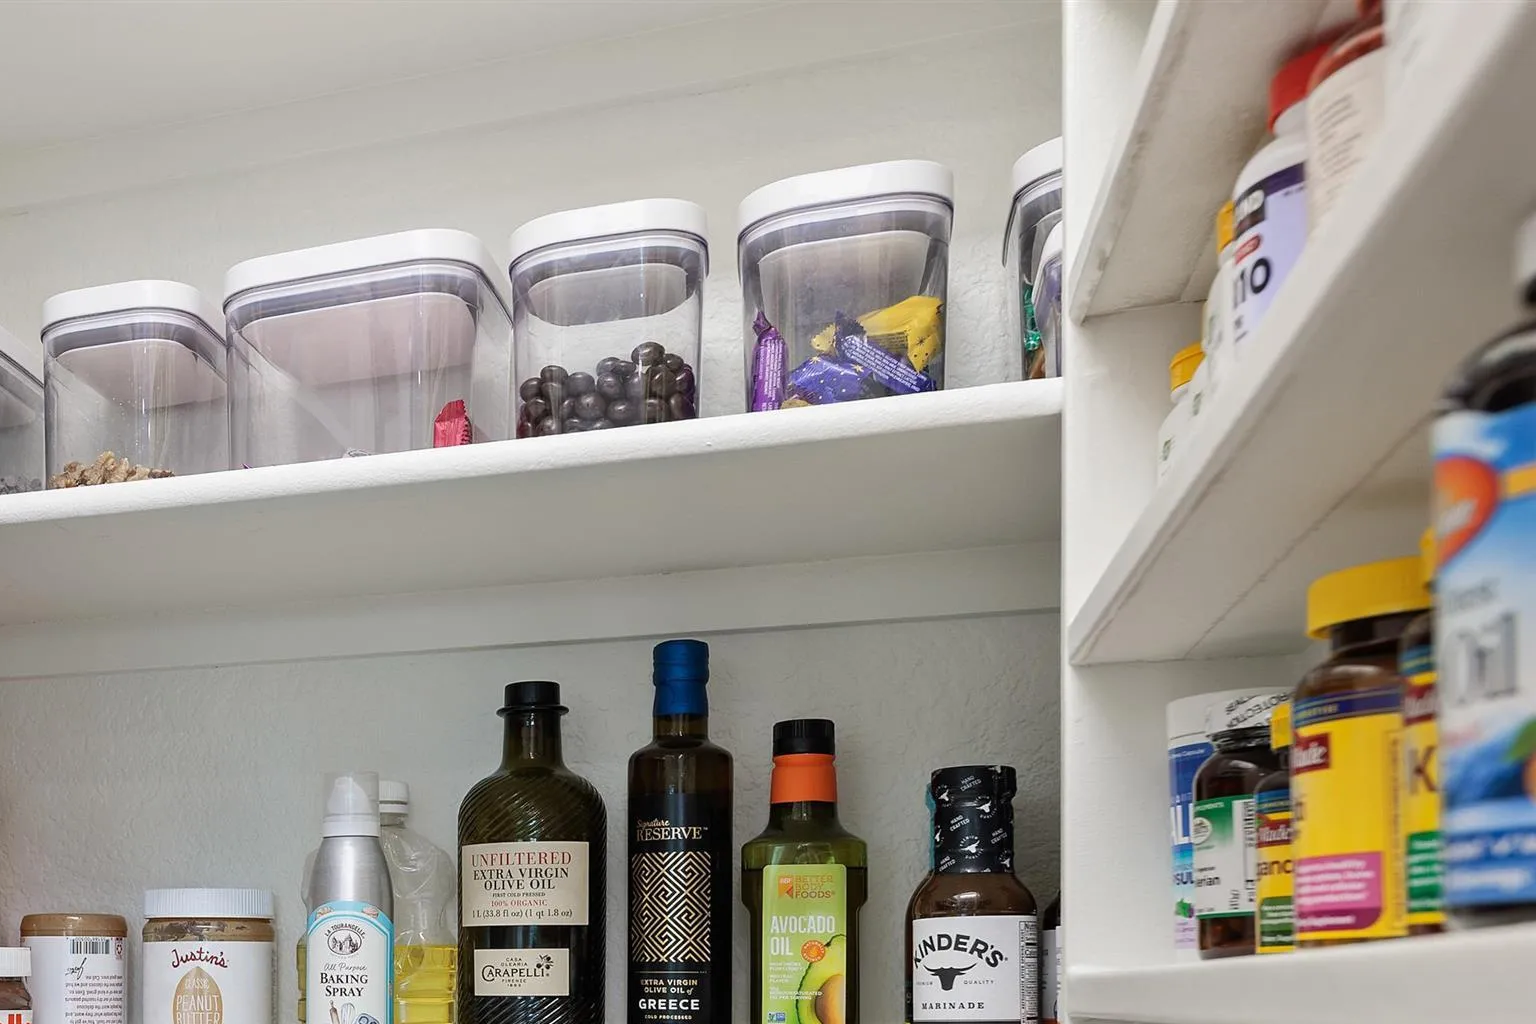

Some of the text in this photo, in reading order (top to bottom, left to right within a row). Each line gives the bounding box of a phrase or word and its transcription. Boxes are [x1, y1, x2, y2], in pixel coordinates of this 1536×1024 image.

[950, 819, 970, 831] CRAFTED
[637, 827, 702, 842] RESERVE
[472, 851, 572, 868] UNFILTERED
[473, 867, 569, 881] EXTRA VIRGIN
[795, 875, 833, 883] BETTER
[484, 879, 556, 891] OLIVE OIL
[795, 883, 824, 891] BODY
[795, 890, 832, 899] FOODS
[510, 899, 548, 907] ORGANIC
[770, 916, 835, 933] AVOCADO
[331, 922, 366, 940] TOURANGELLE
[770, 937, 793, 956] OIL
[172, 947, 228, 968] Justin's
[320, 973, 368, 985] BAKING
[482, 964, 545, 982] CARAPELLI
[325, 986, 365, 997] SPRAY
[176, 995, 219, 1011] PEANUT
[639, 998, 700, 1010] GREECE
[921, 1002, 985, 1010] MARINADE
